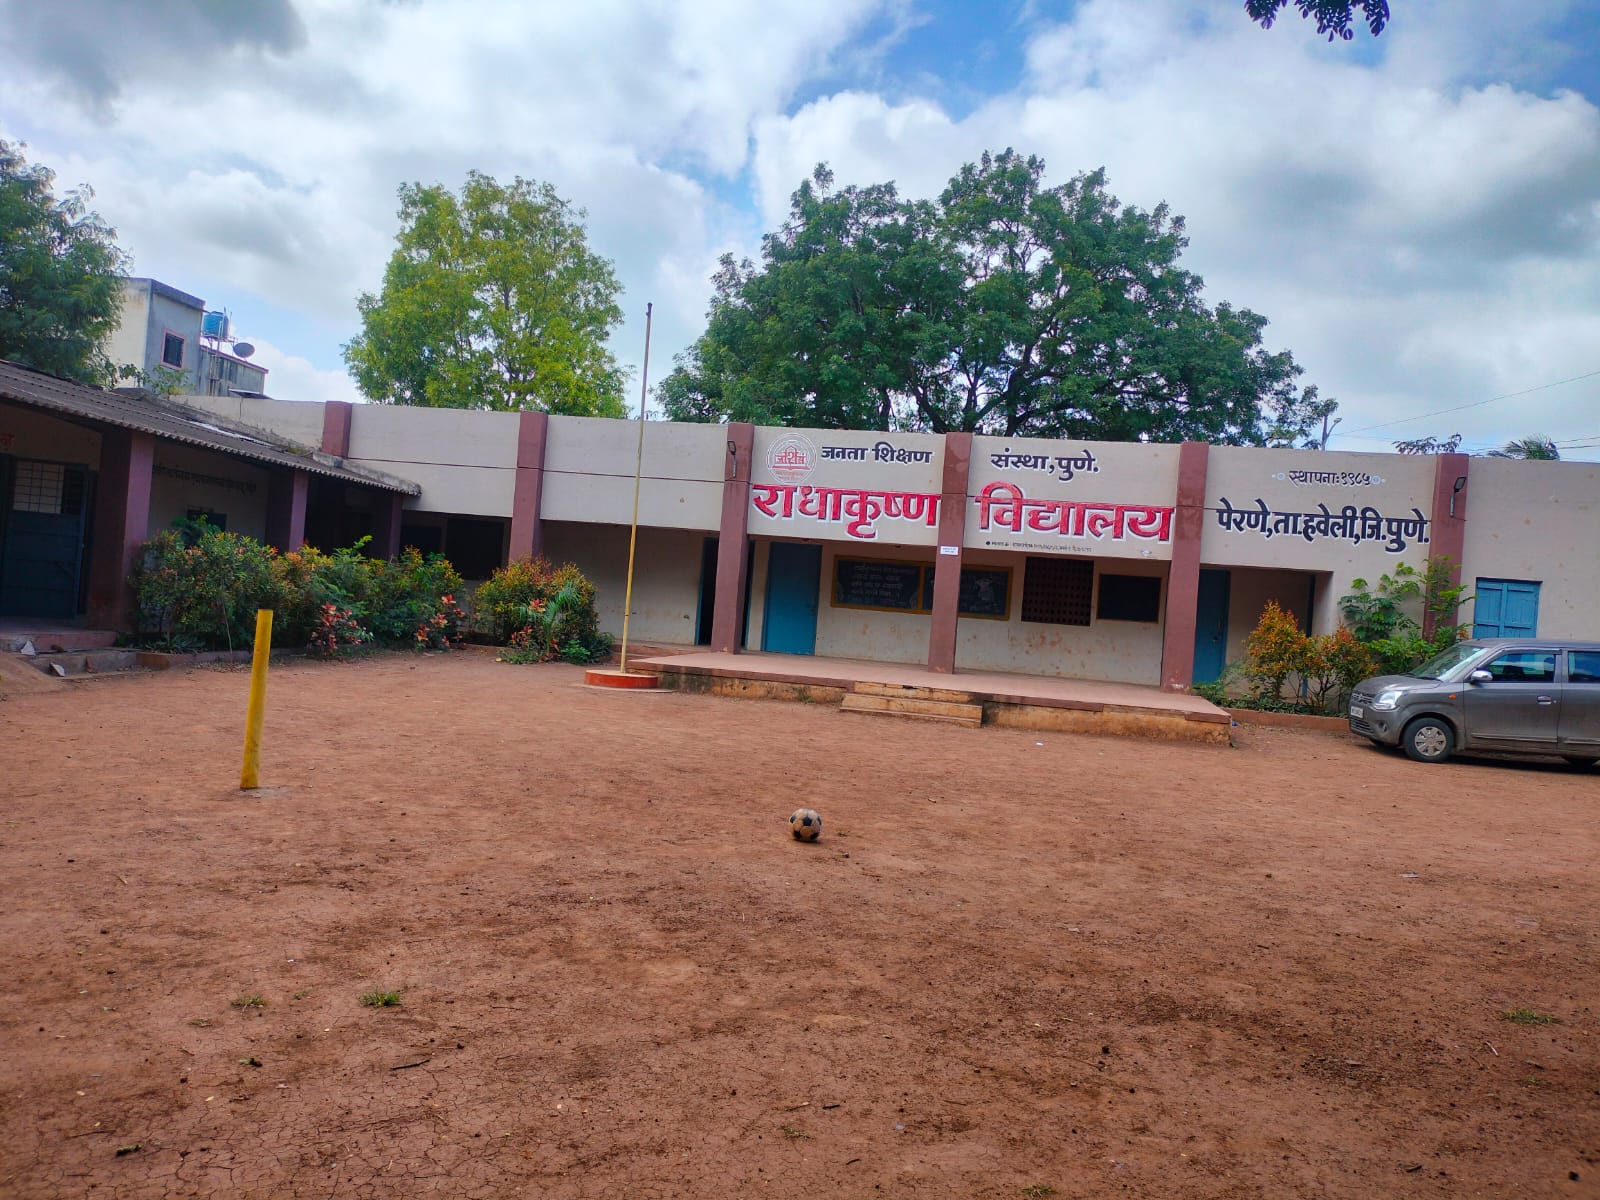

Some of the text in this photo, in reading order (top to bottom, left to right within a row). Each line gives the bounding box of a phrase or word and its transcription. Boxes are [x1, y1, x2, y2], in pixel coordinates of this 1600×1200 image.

[820, 445, 867, 461] जनता
[872, 441, 933, 464] शिक्षण
[752, 481, 1175, 541] राधाकृष्ण विद्यालय
